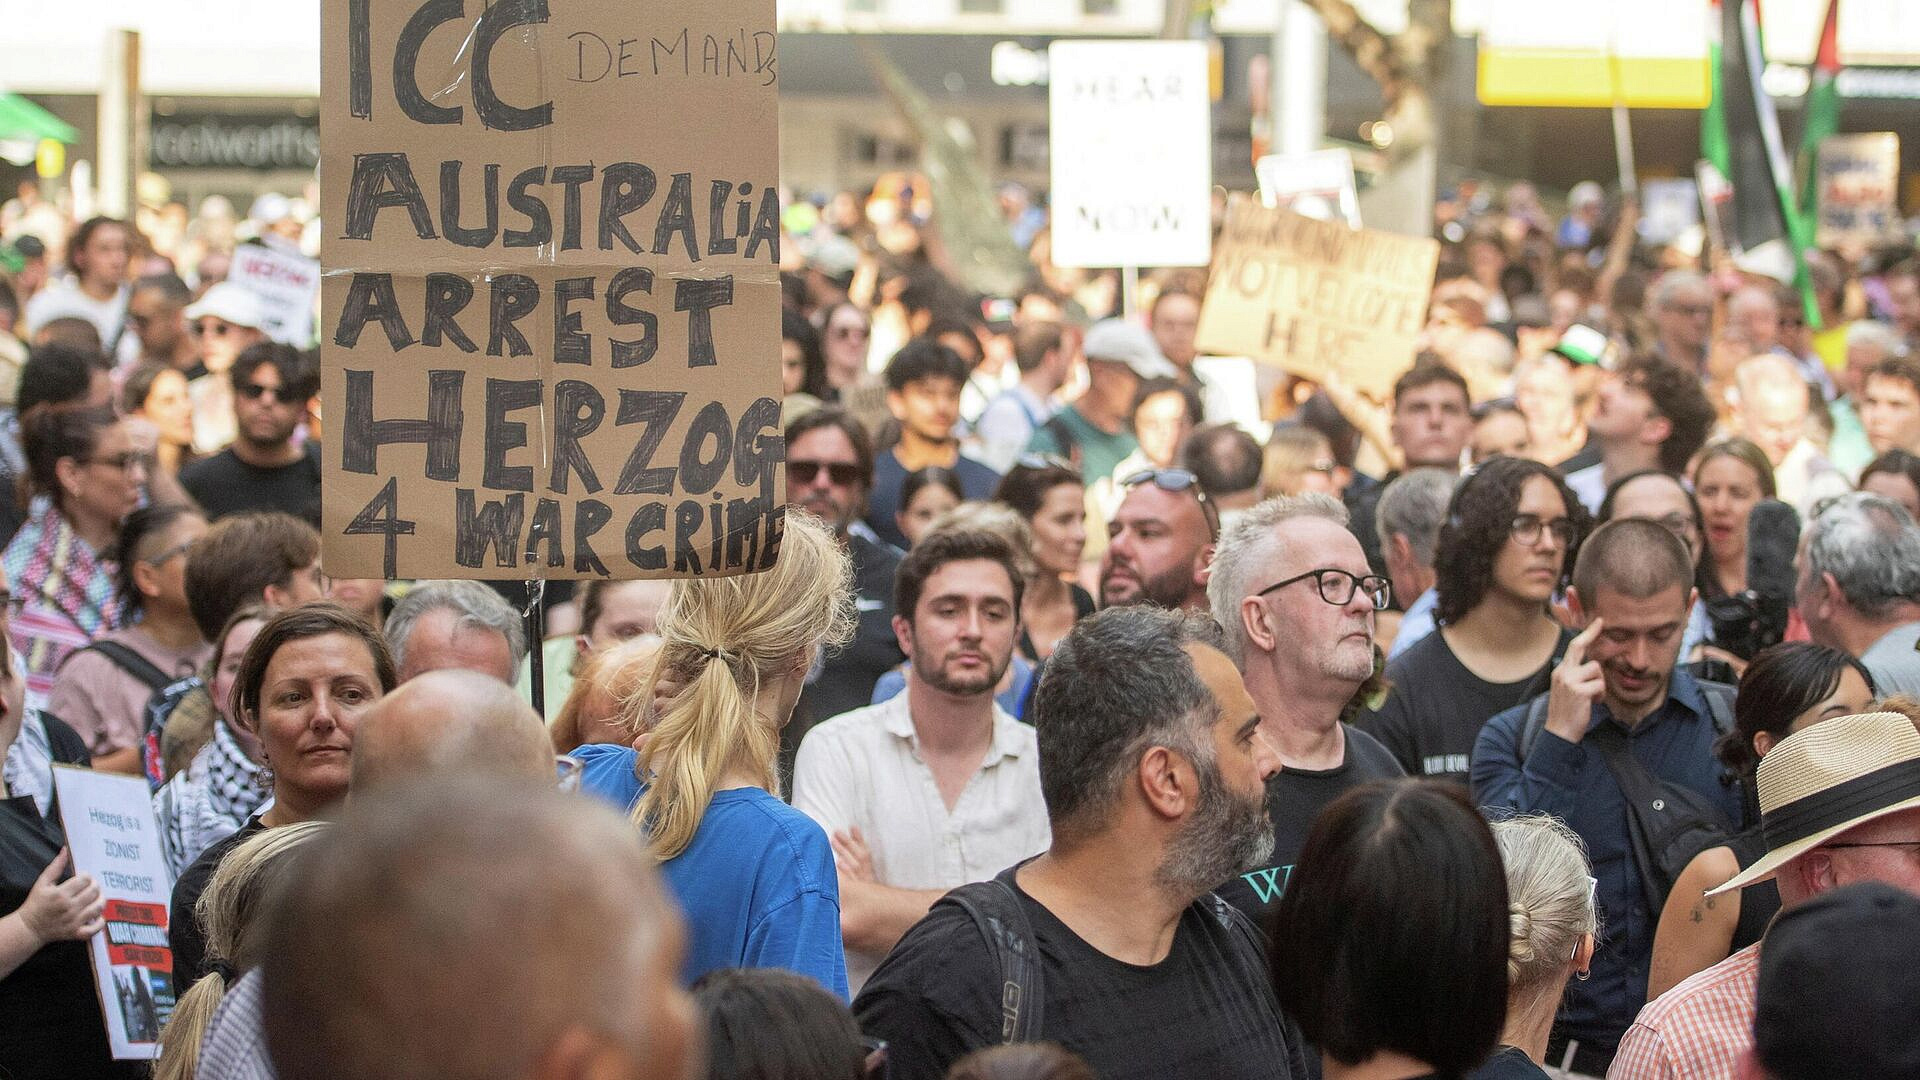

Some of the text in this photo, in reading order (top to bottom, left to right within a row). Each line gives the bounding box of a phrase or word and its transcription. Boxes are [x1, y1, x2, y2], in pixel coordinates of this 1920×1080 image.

[349, 0, 777, 131] ICC DEMANDS
[1074, 203, 1186, 231] NOW
[333, 267, 734, 368] ARREST
[342, 369, 786, 512] HERZOG
[343, 476, 416, 579] 4
